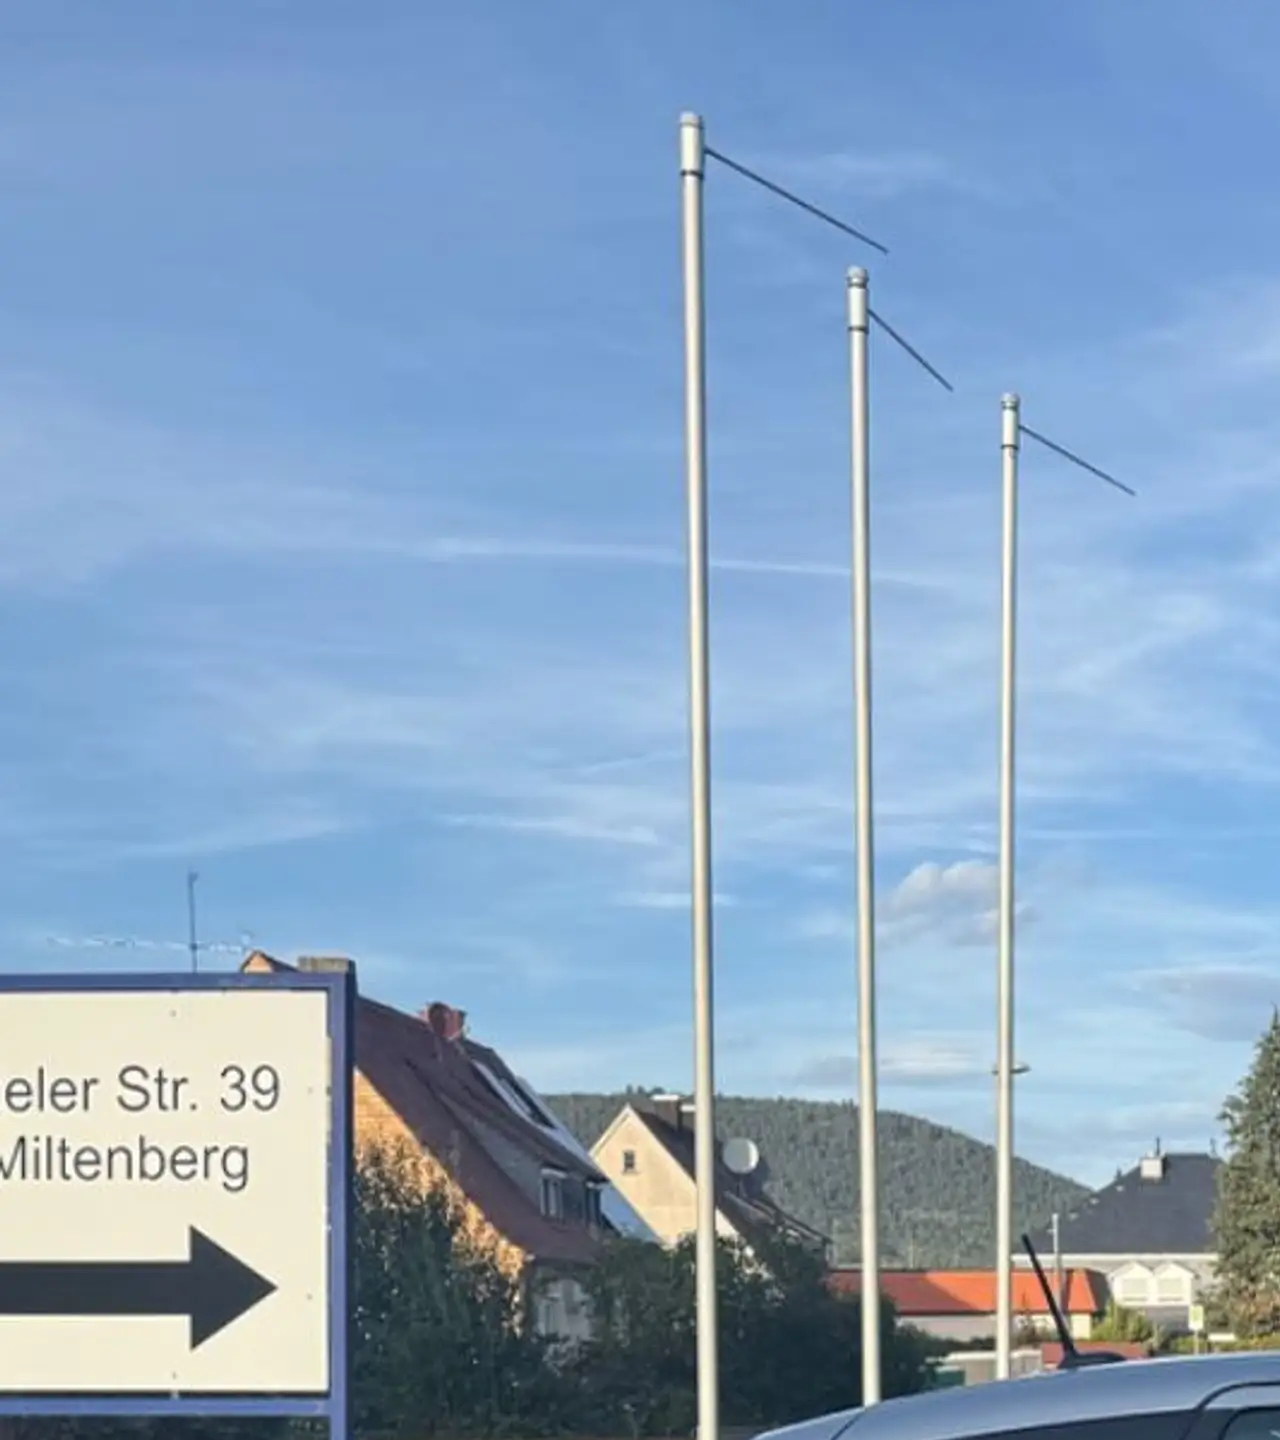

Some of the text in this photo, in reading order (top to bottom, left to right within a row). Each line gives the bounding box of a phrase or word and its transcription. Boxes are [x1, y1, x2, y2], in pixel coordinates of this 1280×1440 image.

[4, 1064, 280, 1113] eler Str. 39
[0, 1134, 249, 1193] Miltenberg
